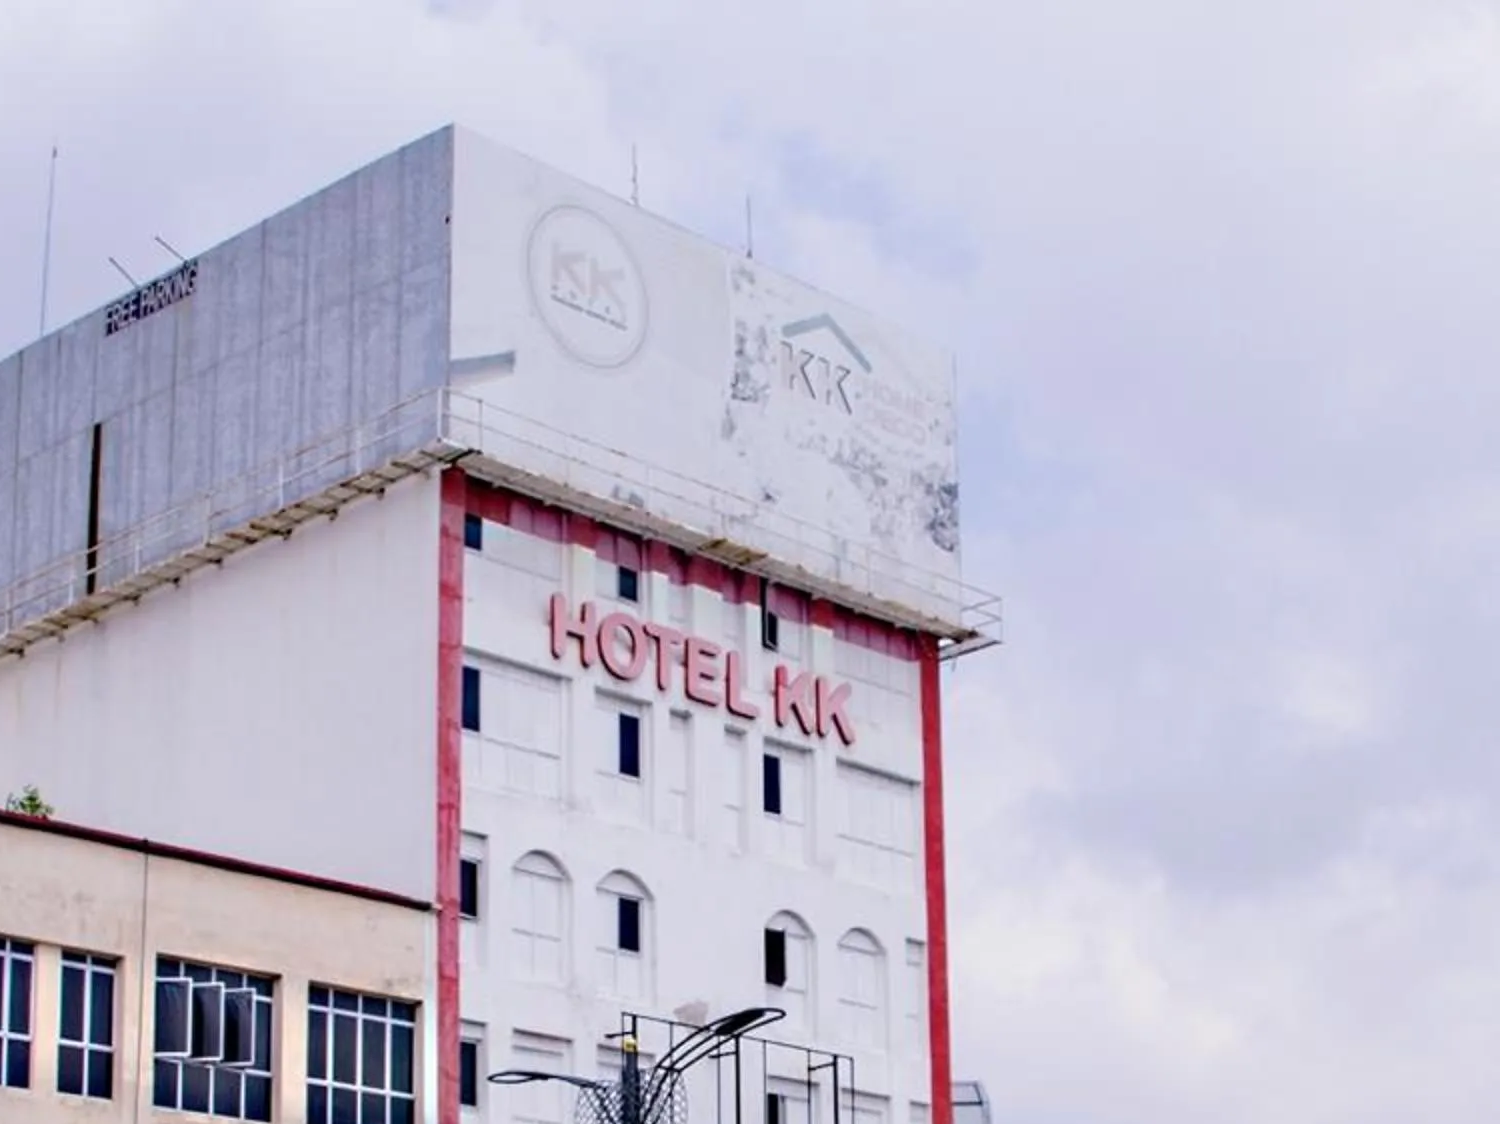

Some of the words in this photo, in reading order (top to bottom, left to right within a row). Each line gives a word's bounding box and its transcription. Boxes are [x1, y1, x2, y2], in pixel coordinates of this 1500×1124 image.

[104, 296, 137, 335] FREE
[140, 264, 198, 317] PARKING
[548, 592, 759, 720] HOTEL
[773, 644, 854, 745] KK
